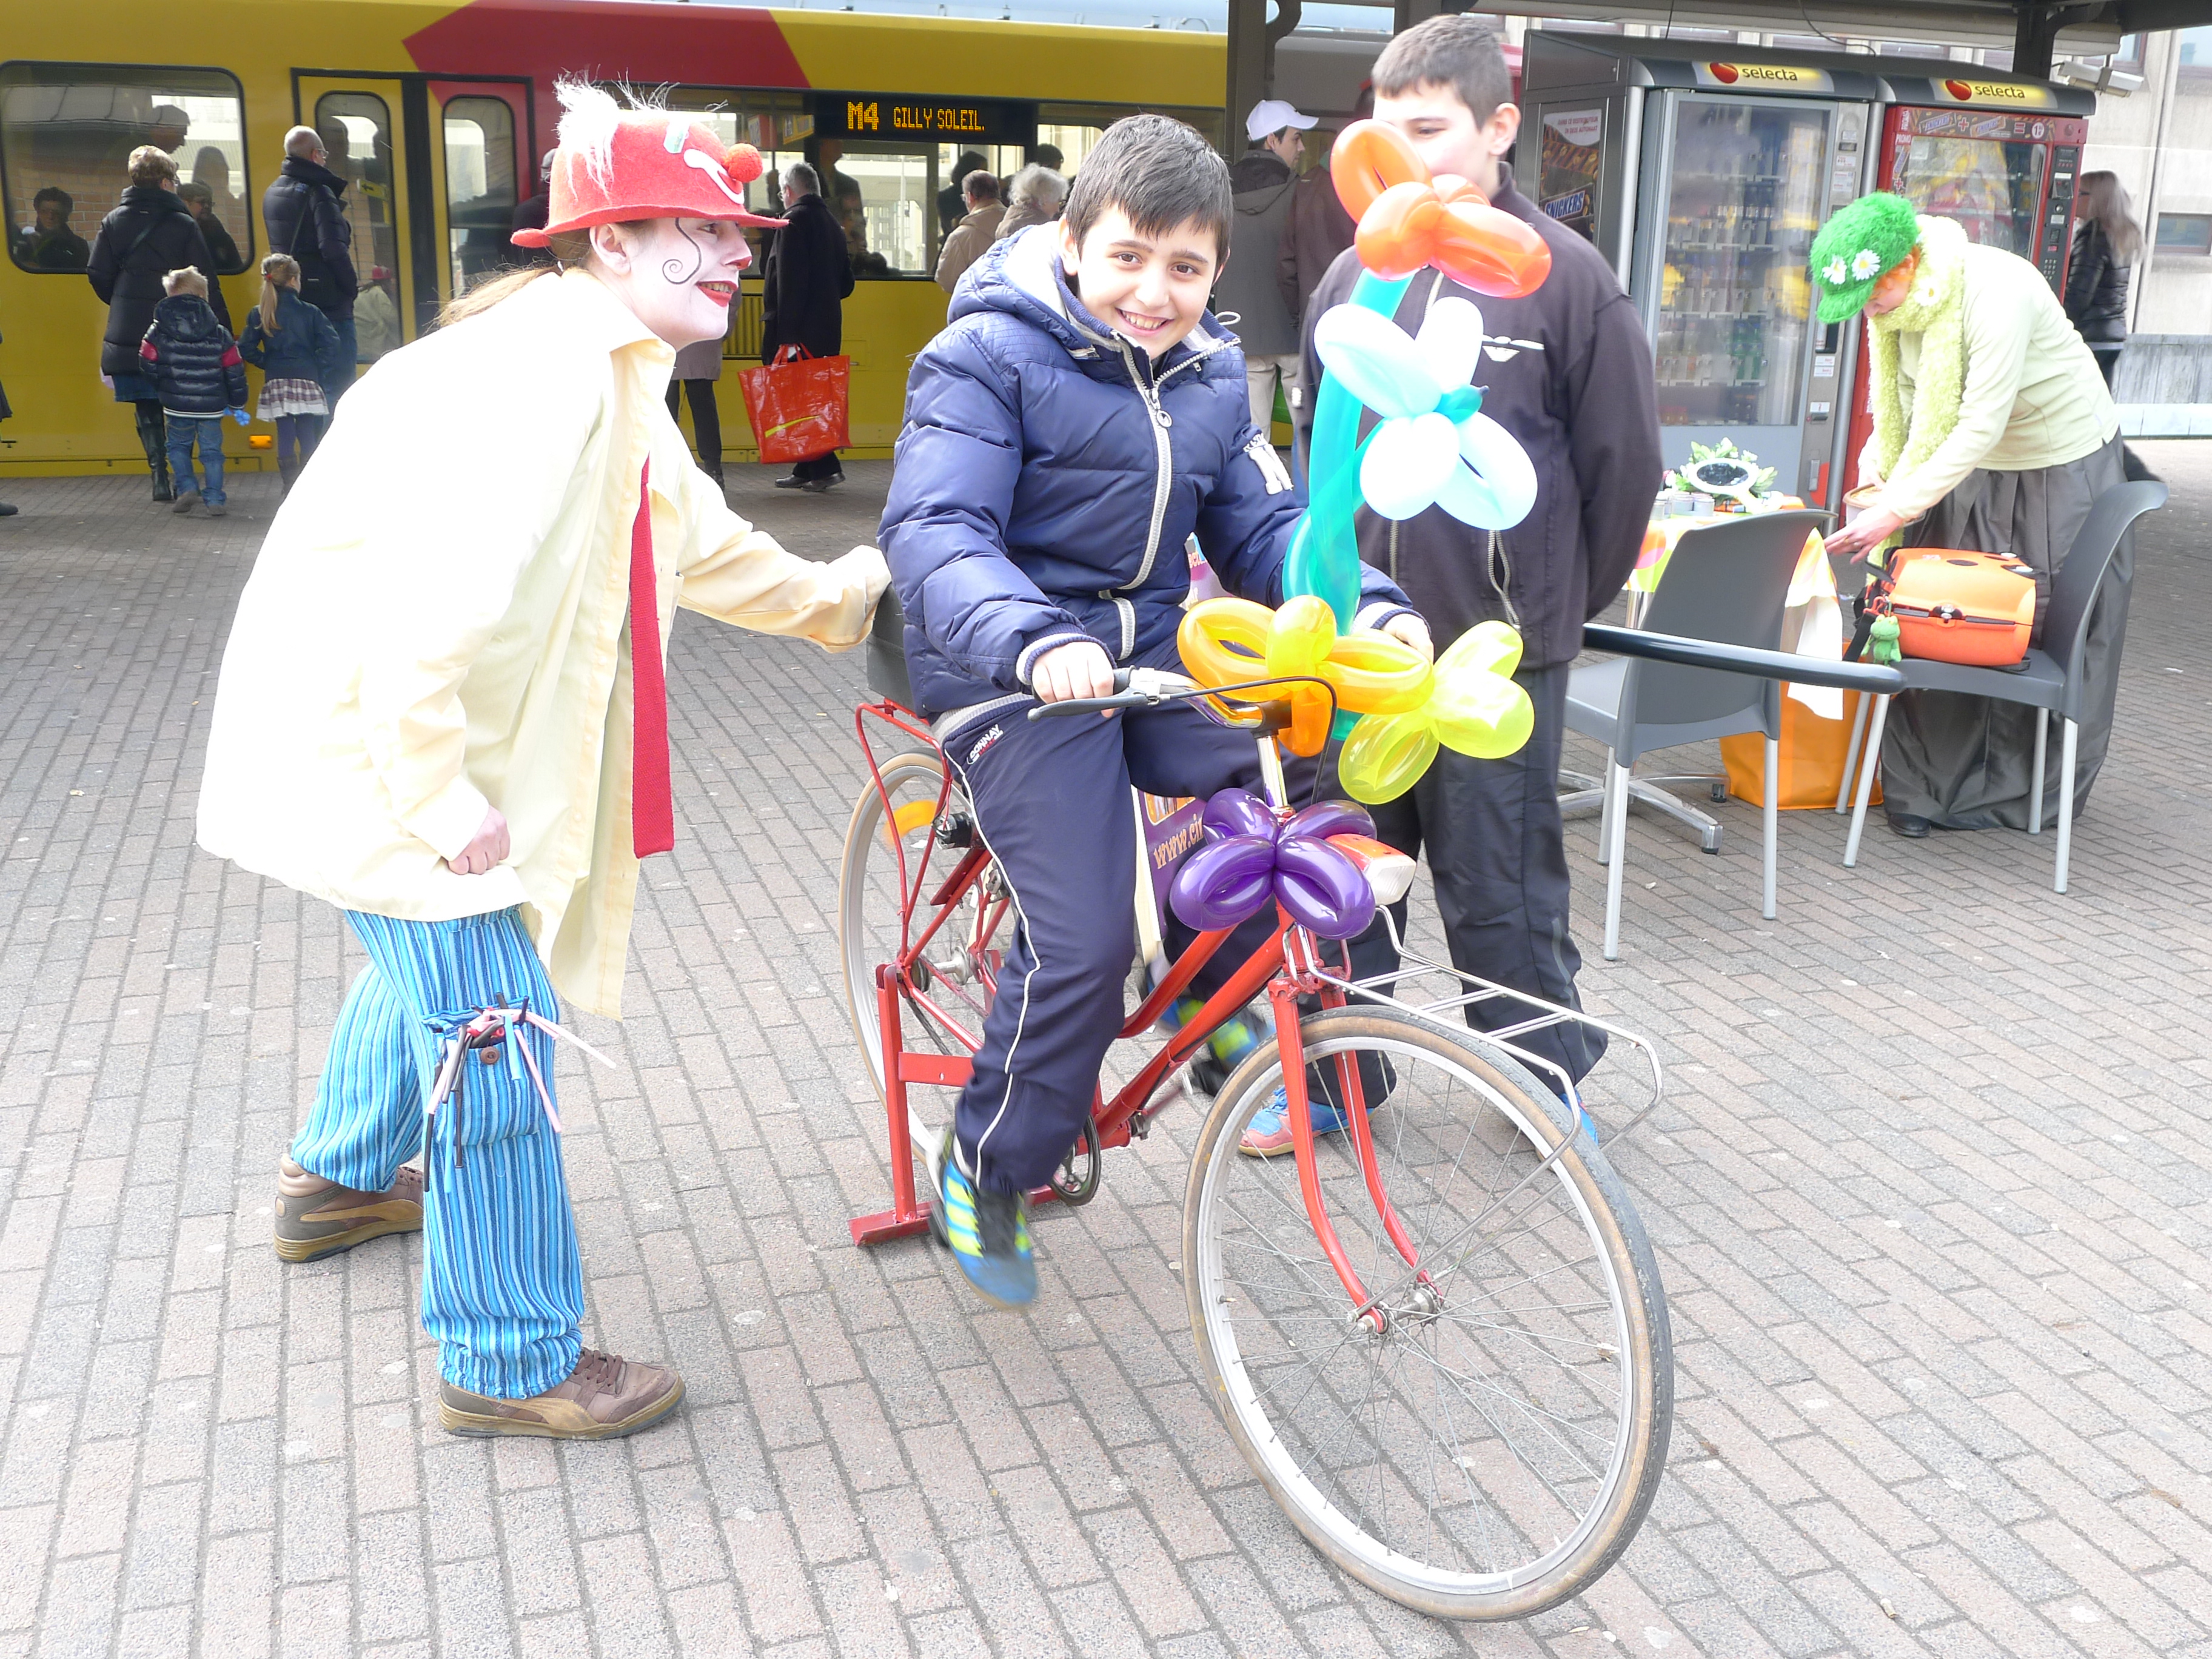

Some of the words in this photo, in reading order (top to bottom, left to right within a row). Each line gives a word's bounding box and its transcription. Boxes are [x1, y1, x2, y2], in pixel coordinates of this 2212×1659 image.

[1742, 67, 1798, 81] selecta
[1974, 85, 2025, 98] selecta
[847, 101, 879, 130] M4
[894, 107, 932, 129] GILLY
[1546, 192, 1584, 218] SNICKERS
[970, 724, 1000, 759] DONNAY
